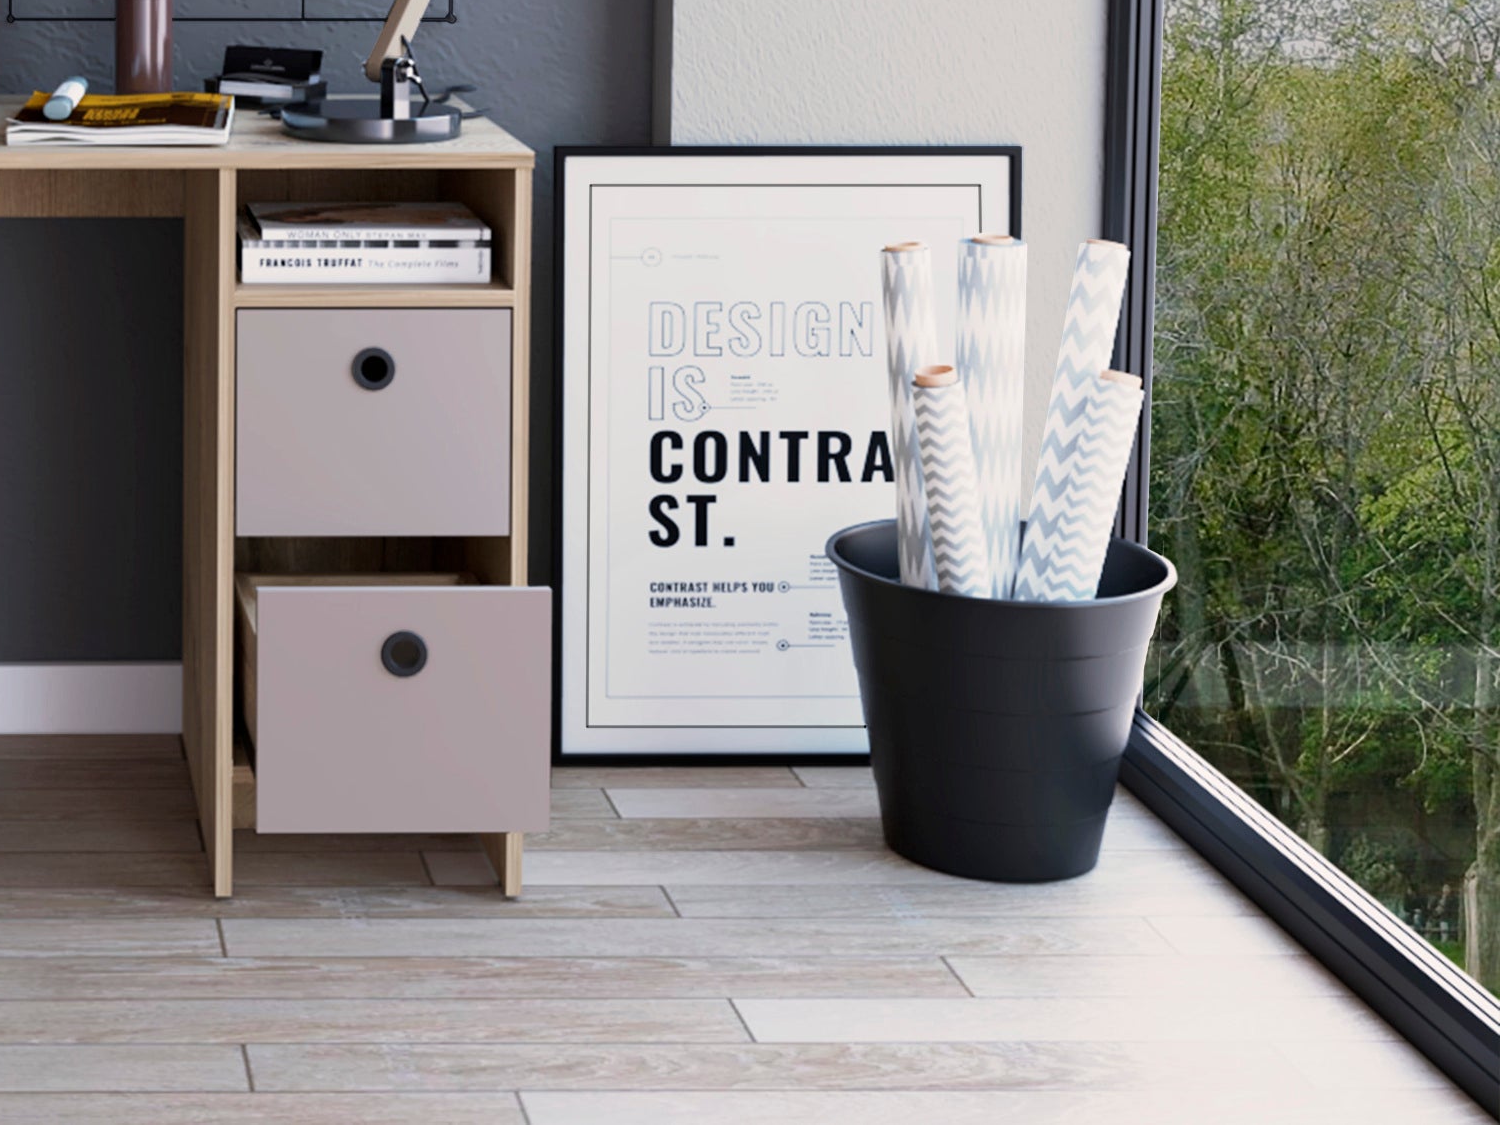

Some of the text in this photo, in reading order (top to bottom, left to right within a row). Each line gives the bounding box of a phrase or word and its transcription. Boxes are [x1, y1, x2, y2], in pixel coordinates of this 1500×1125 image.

[287, 230, 329, 239] WOMAN
[333, 230, 361, 239] ONLY
[387, 259, 432, 270] Complete
[435, 259, 460, 269] Films
[648, 300, 874, 358] DESIGN
[647, 365, 707, 423] IS
[649, 429, 896, 484] CONTRA
[647, 493, 736, 548] ST.
[649, 581, 775, 593] CONTRAST HELPS YOU
